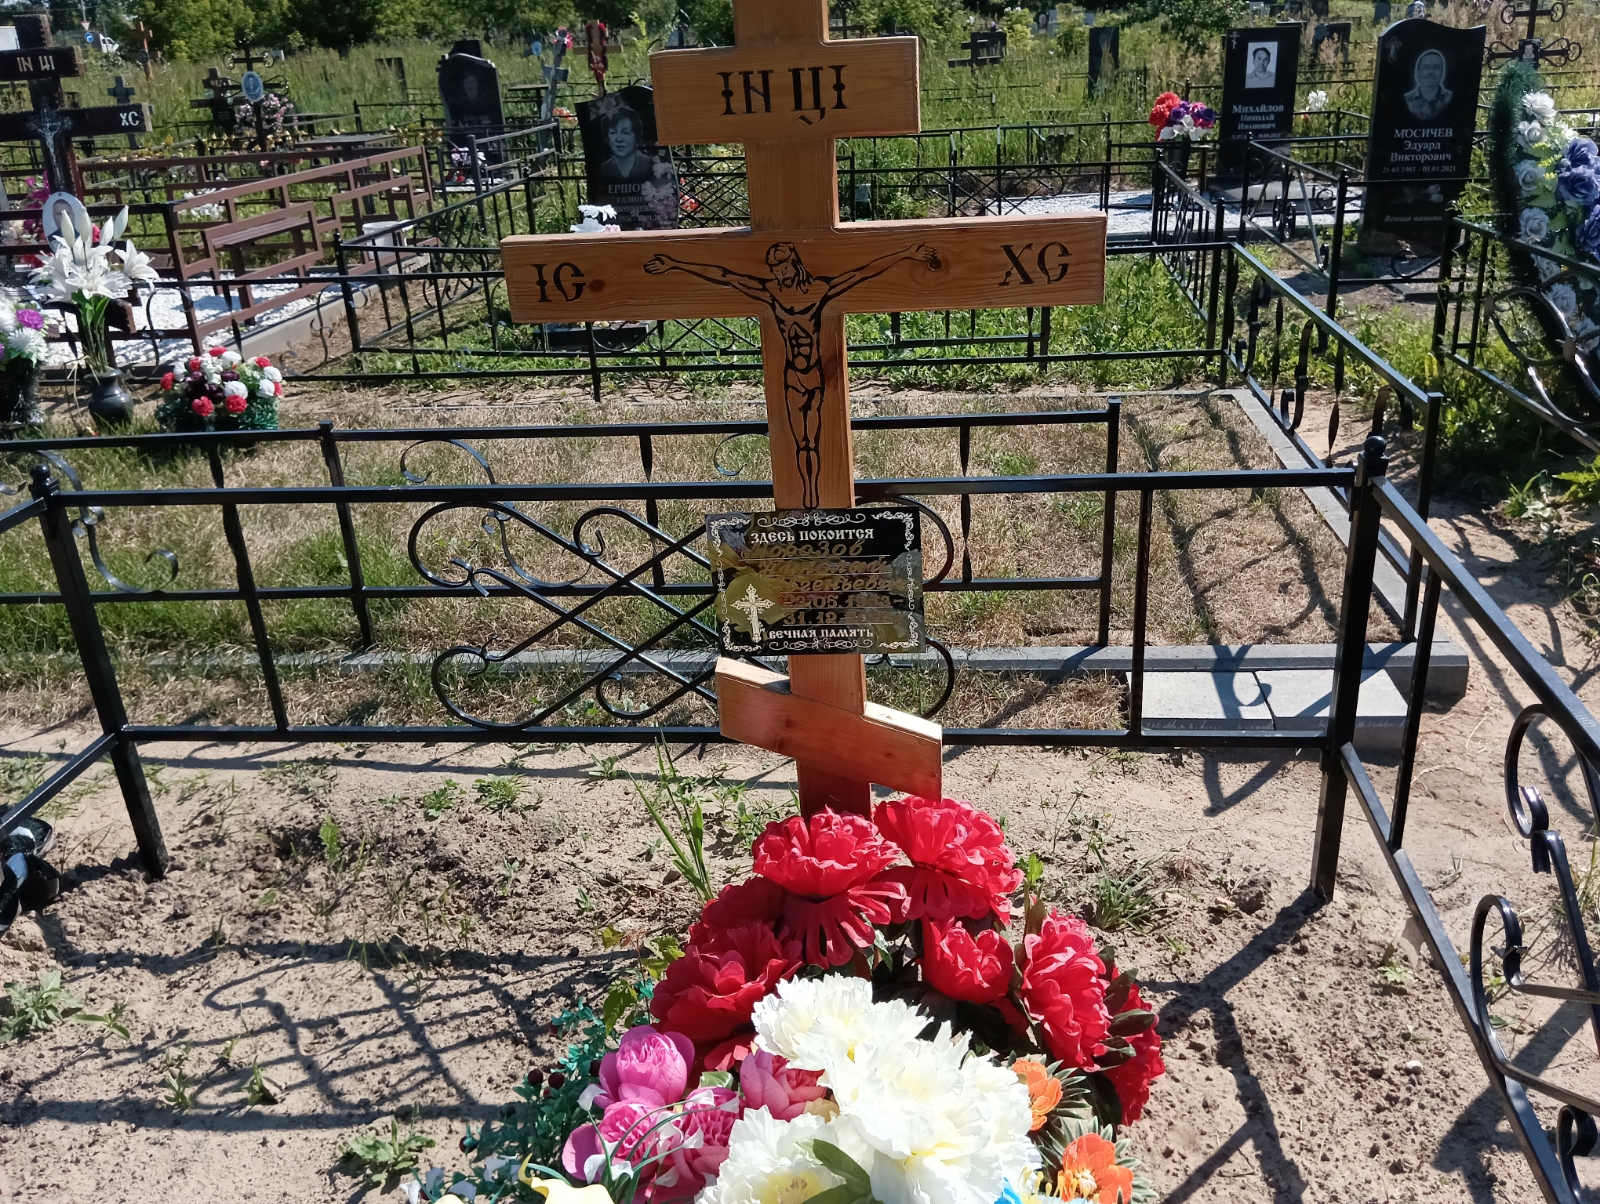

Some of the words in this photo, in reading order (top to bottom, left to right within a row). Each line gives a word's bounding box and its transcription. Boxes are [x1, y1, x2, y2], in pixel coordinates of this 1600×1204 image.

[1394, 128, 1453, 139] МОСИЧЕВ
[1404, 140, 1441, 151] Эдуард
[1390, 152, 1452, 164] Викторович
[799, 528, 874, 541] ПОКОИТСЯ
[769, 629, 817, 639] ВЕЧНАЯ
[820, 628, 874, 639] ПАМЯТЬ
